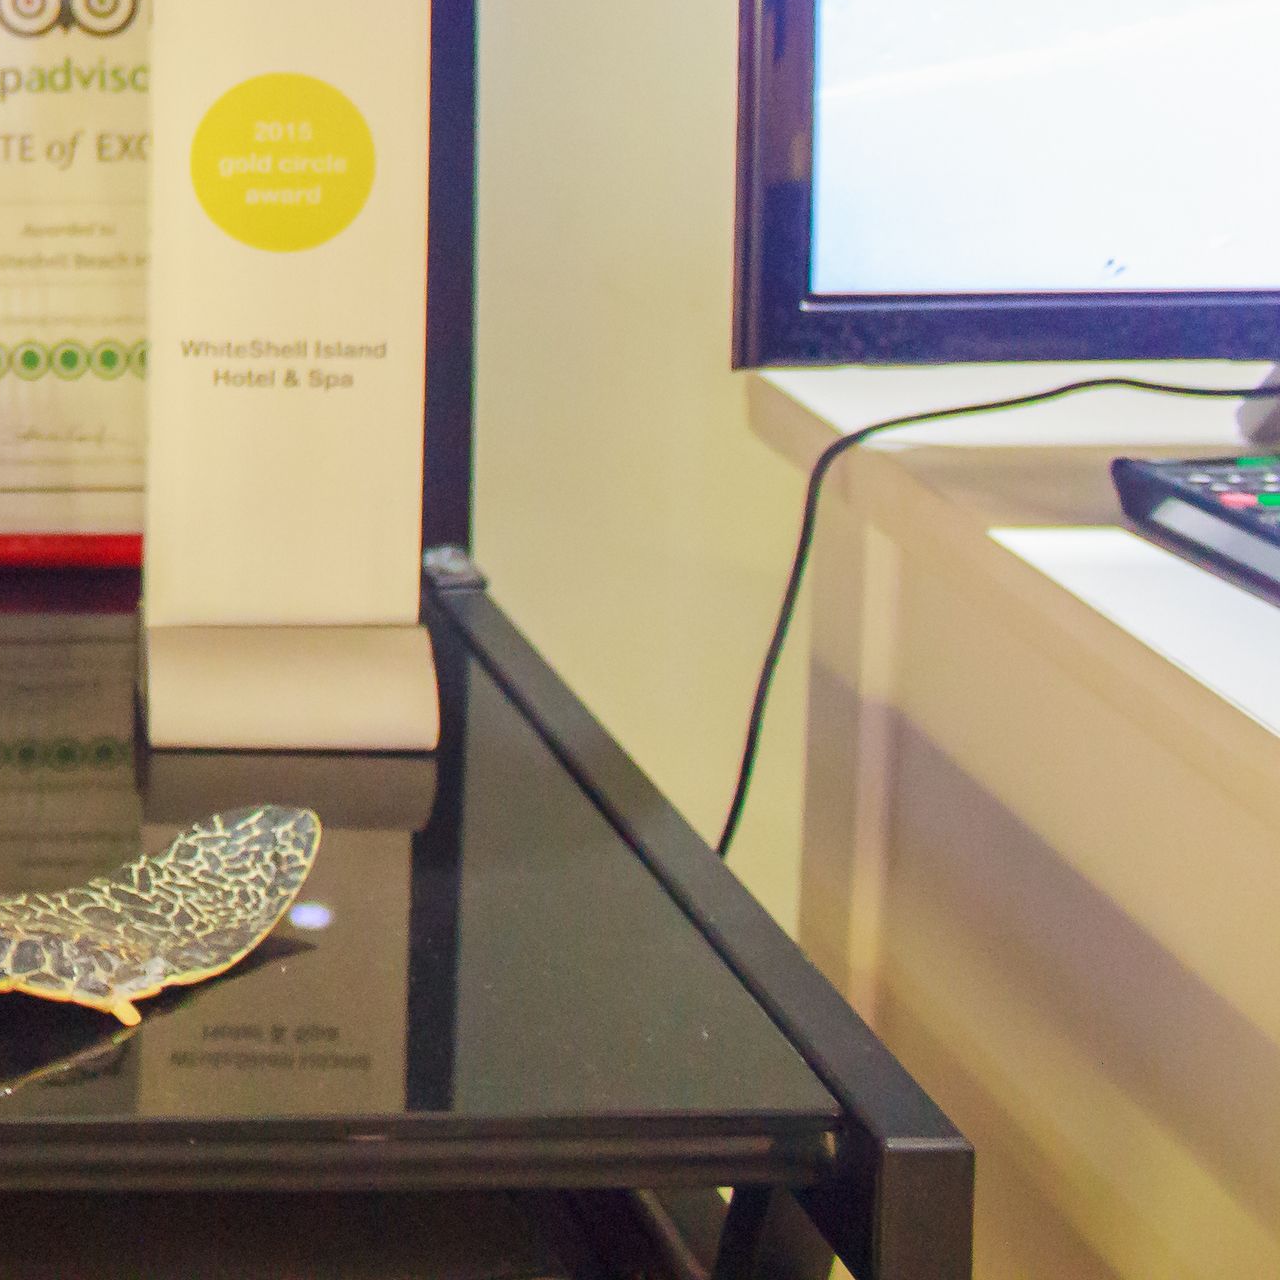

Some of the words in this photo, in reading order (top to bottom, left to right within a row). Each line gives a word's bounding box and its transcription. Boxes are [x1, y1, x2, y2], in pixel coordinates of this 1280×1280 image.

[254, 121, 313, 143] 2015
[45, 130, 85, 171] of
[218, 153, 273, 177] gold
[278, 152, 347, 175] circle
[244, 185, 322, 206] award
[181, 340, 308, 361] WhiteShell
[314, 340, 387, 361] Island
[213, 369, 275, 389] Hotel
[283, 370, 299, 389] &
[309, 369, 354, 391] Spa
